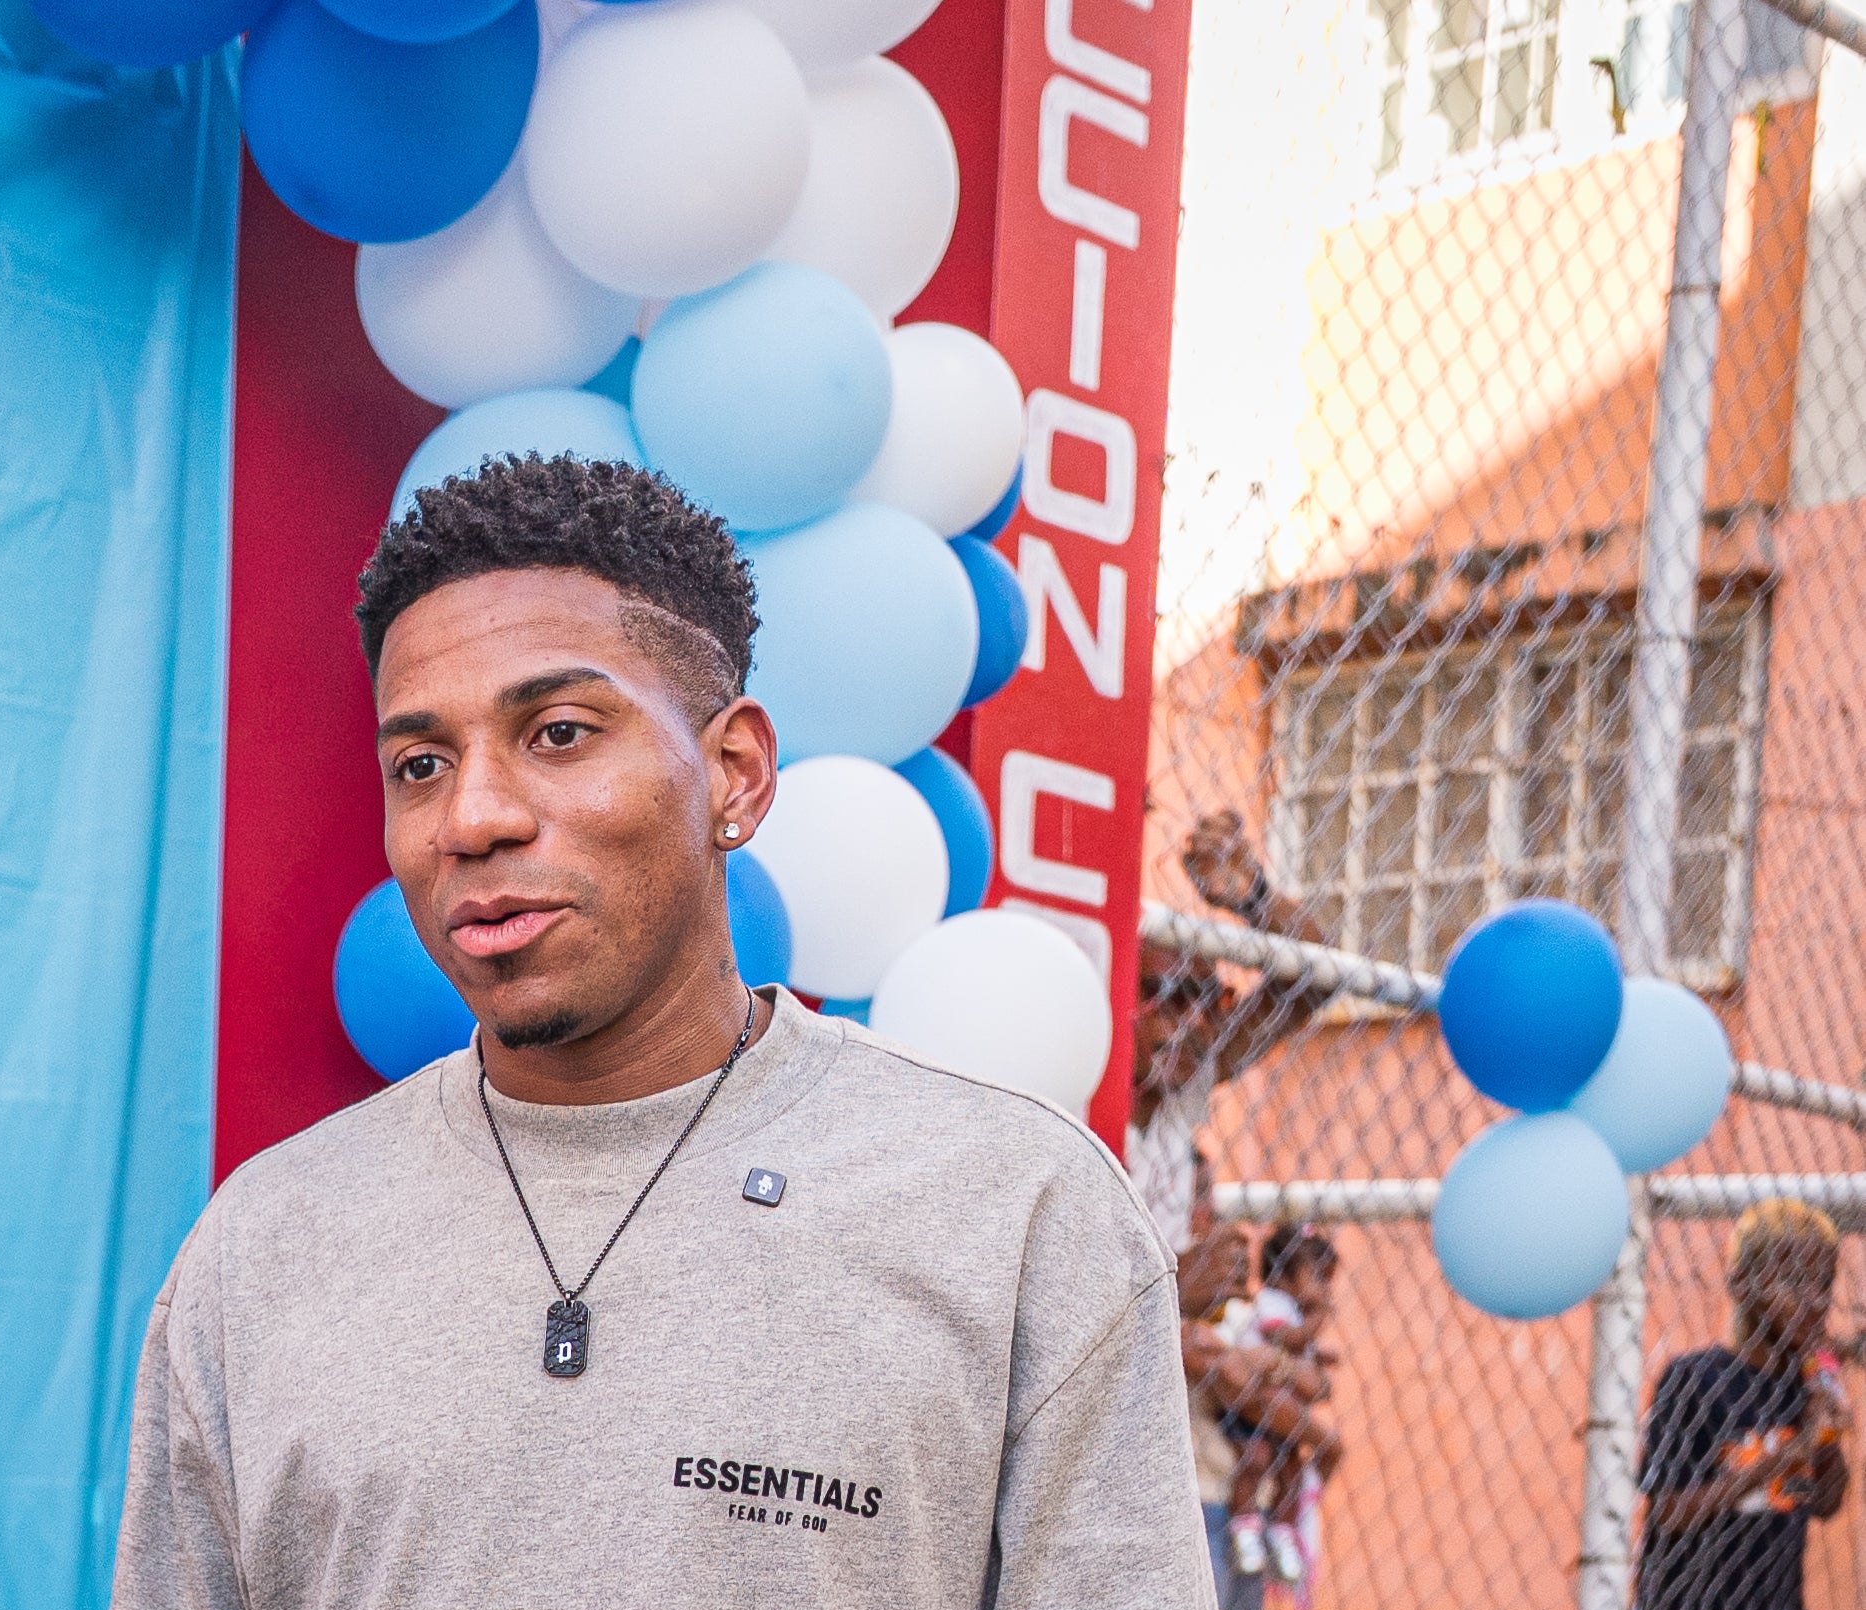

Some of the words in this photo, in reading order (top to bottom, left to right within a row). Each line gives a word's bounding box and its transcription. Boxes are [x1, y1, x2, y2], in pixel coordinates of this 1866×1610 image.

[674, 1456, 884, 1519] ESSENTIALS
[728, 1503, 767, 1523] FEAR
[775, 1510, 793, 1527] OF
[801, 1514, 828, 1534] GOD
